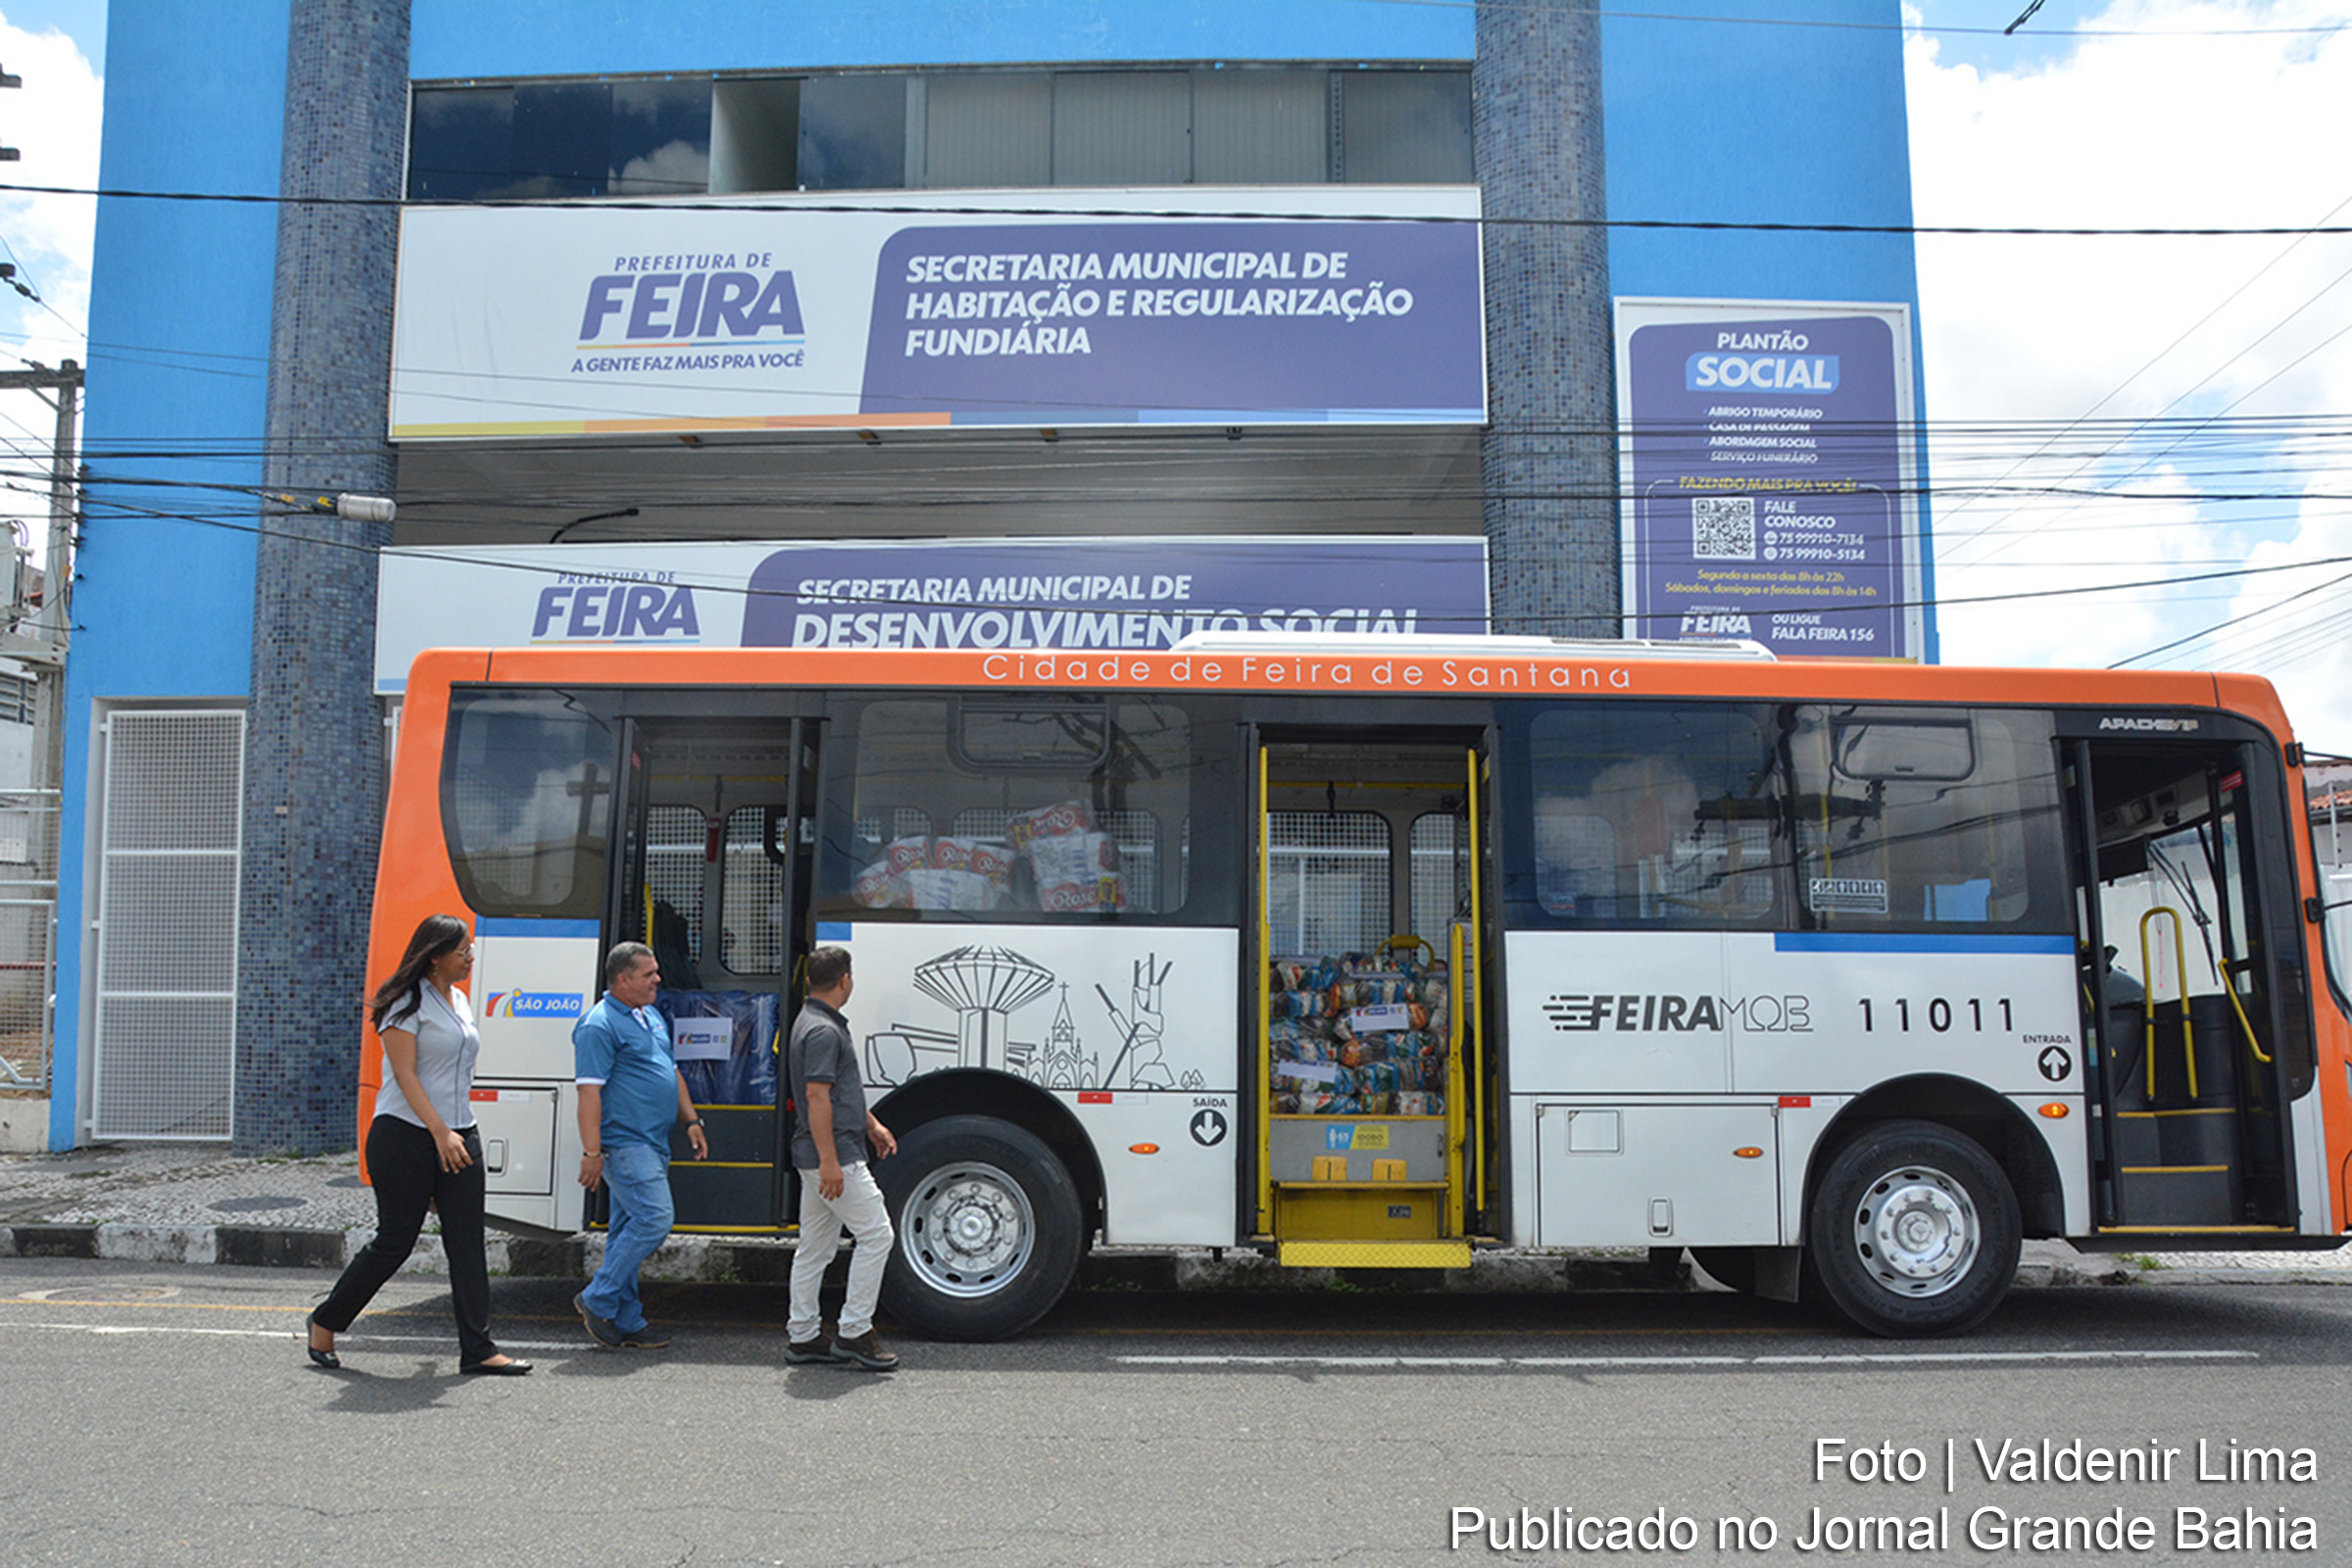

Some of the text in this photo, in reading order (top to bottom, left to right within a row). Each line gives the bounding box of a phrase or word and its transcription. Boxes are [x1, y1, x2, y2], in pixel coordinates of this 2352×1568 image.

[614, 252, 772, 272] PREFEITURA DE
[906, 252, 1348, 283] SECRETARIA MUNICIPAL DE
[579, 270, 805, 341] FEIRA
[906, 280, 1414, 324] HABITAÇÃO E REGULARIZAÇÃO
[905, 320, 1092, 357] FUNDIÁRIA
[1717, 329, 1809, 351] PLANTÃO
[570, 349, 805, 372] A GENTE FAZ MAIS PRA VOCÊ
[1695, 356, 1832, 389] SOCIAL
[1708, 407, 1823, 418] ABRIGO TEMPORÁRIO
[1709, 436, 1817, 448] ABORDAGEM SOCIAL
[1680, 476, 1745, 490] FAZENDO
[1746, 478, 1784, 490] MAIS
[1765, 501, 1796, 513] FALE
[1765, 515, 1837, 529] CONOSCO
[1779, 532, 1794, 544] 75
[1779, 548, 1794, 559] 75
[657, 570, 676, 583] DE
[1697, 569, 1740, 582] Segunda
[797, 574, 1193, 605] SECRETARIA MUNICIPAL DE
[532, 585, 700, 637] FEIRA
[1772, 614, 1821, 625] OU LIGUE
[792, 609, 1249, 648] DESENVOLVIMENTO
[1681, 612, 1752, 633] FEIRA
[1772, 626, 1876, 641] FALA FEIRA 156
[983, 655, 1631, 688] Cidade de Feira de Santana
[514, 997, 580, 1010] SÃO JOÃO
[1858, 998, 2012, 1032] 11011
[2023, 1035, 2072, 1045] ENTRADA
[1193, 1096, 1227, 1107] SAÍDA
